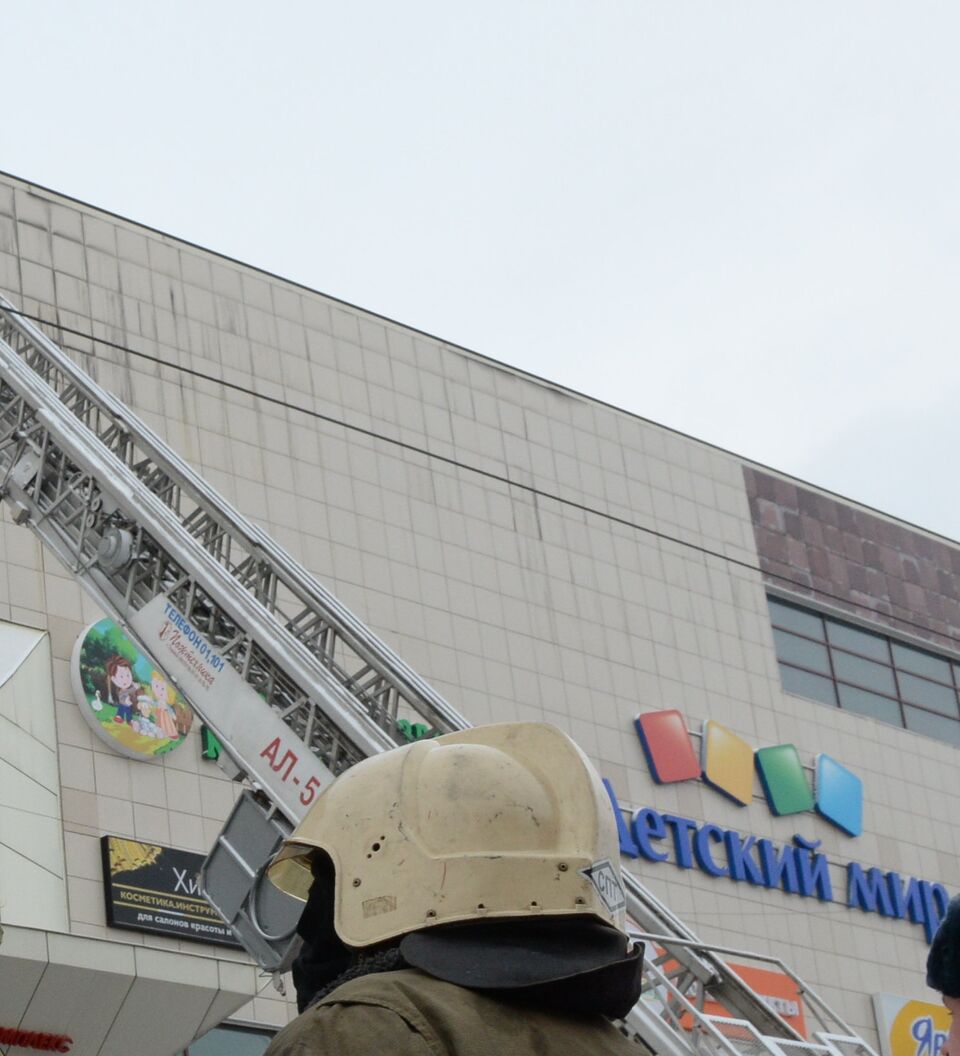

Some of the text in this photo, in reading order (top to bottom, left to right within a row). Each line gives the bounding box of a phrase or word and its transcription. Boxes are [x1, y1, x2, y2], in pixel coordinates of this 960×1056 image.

[164, 602, 202, 649] ТЕЛЕФОН
[137, 912, 153, 924] для
[155, 914, 189, 929] салонов
[190, 922, 225, 936] красоты
[847, 861, 950, 946] мир
